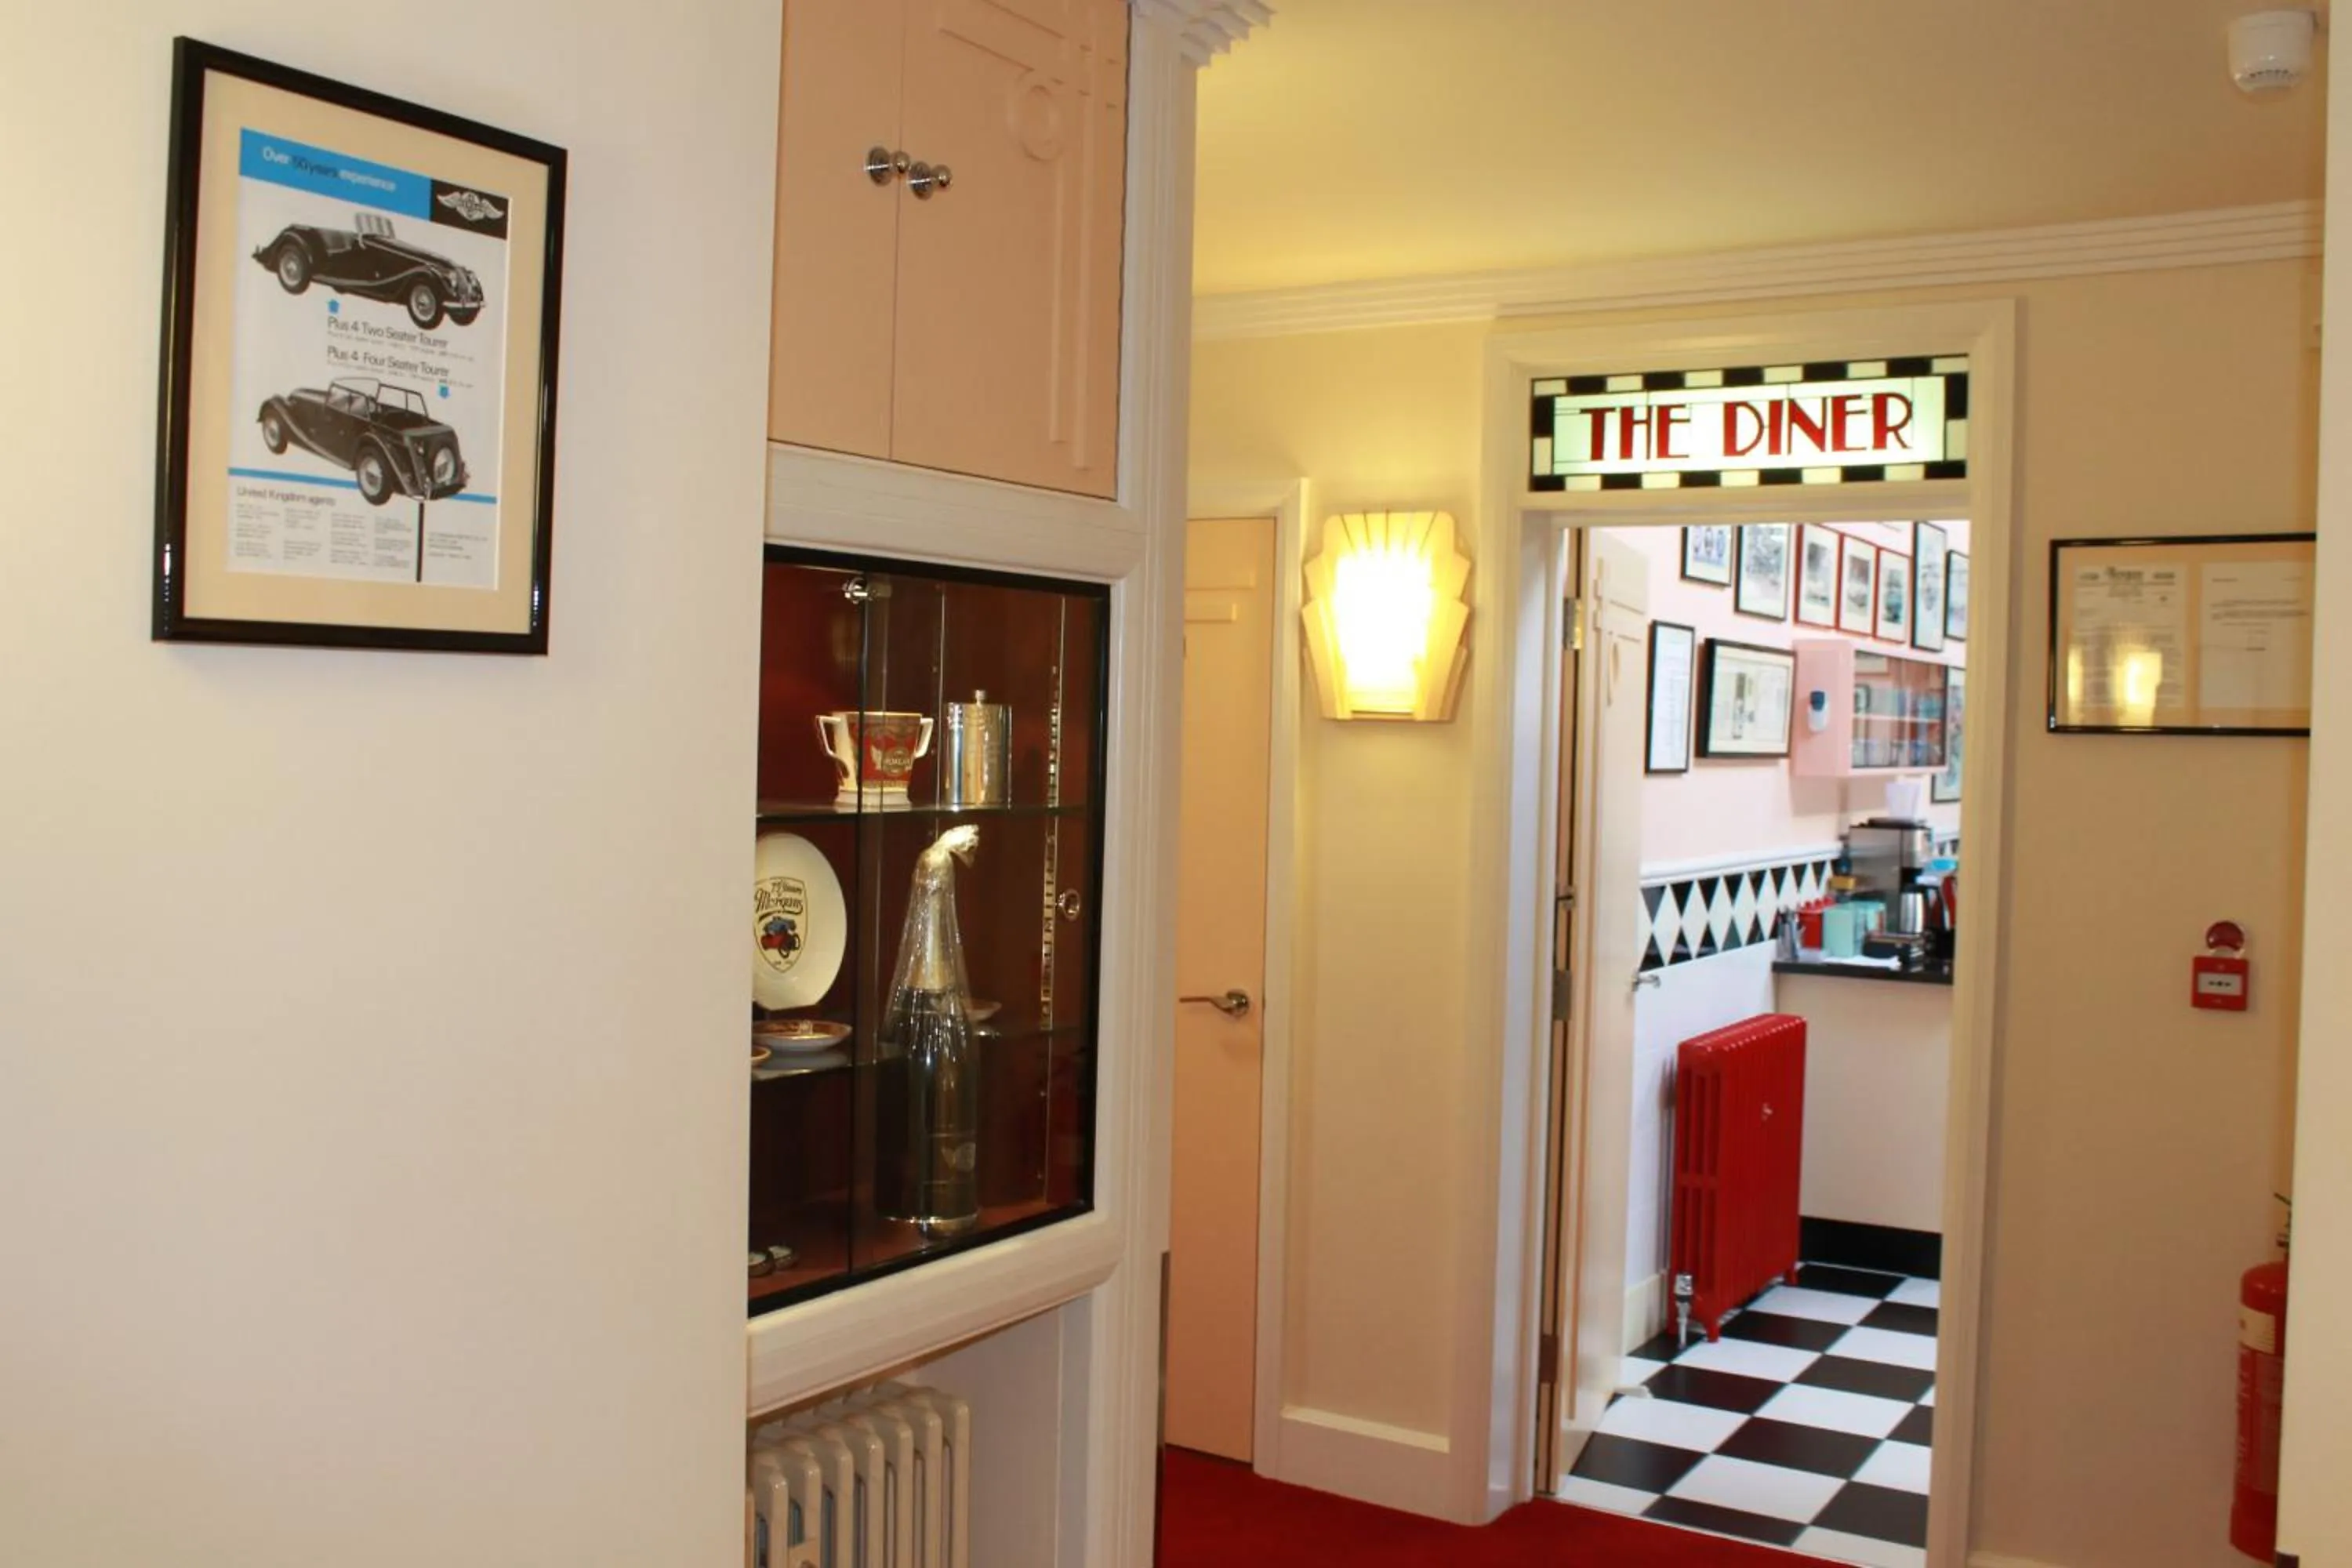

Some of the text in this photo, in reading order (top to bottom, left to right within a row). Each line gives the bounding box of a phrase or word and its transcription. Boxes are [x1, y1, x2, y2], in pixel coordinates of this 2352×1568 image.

[263, 146, 290, 165] Over
[327, 316, 350, 331] Plus
[350, 320, 360, 332] 4
[361, 321, 384, 337] Two
[385, 327, 416, 343] Seater
[419, 332, 448, 348] Tourer
[327, 346, 350, 358] Plus
[350, 350, 360, 361] 4
[363, 351, 386, 365] Four
[387, 357, 418, 372] Seater
[420, 361, 449, 376] Tourer
[1580, 391, 1915, 461] THE DINER
[237, 485, 267, 499] United
[269, 489, 307, 502] Kingdom
